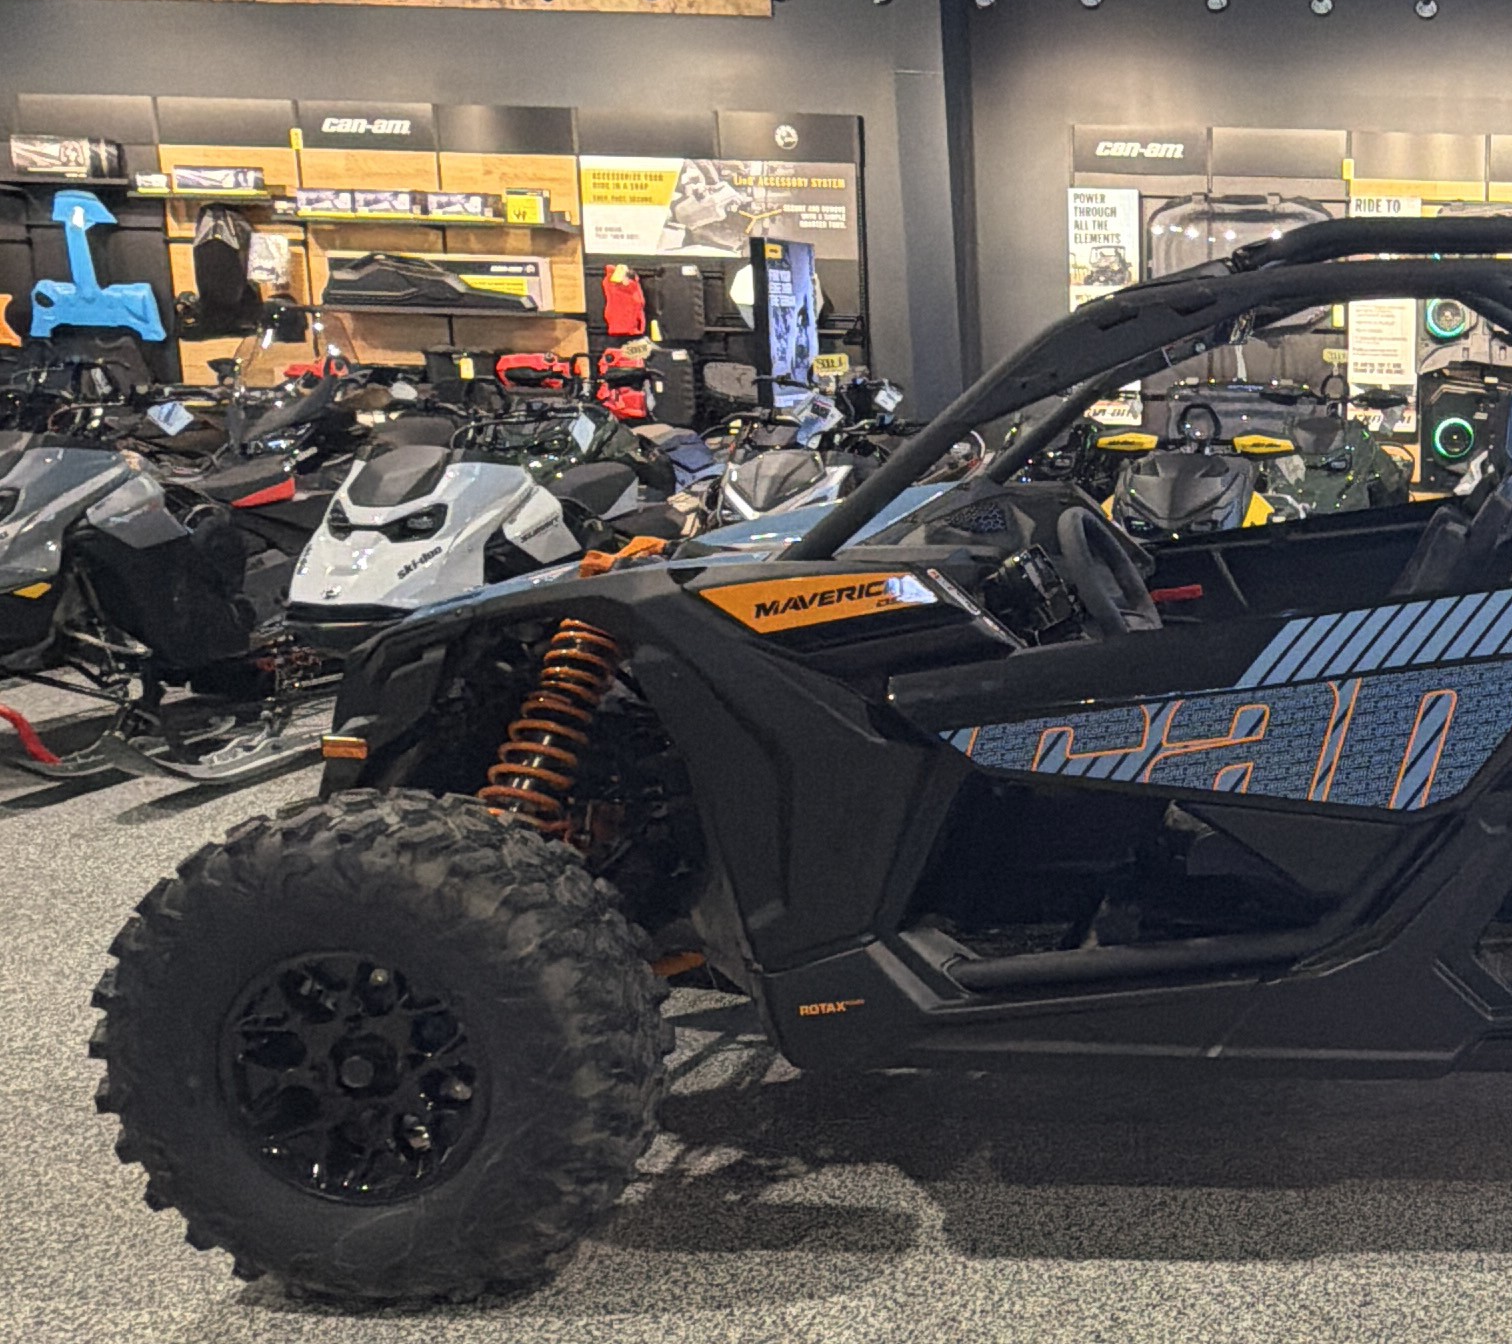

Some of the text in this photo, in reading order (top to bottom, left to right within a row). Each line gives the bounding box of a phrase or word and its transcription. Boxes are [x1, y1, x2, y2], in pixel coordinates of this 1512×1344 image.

[321, 117, 411, 134] can-am
[1095, 140, 1184, 159] can-am
[757, 176, 808, 187] ACCESSORY
[810, 178, 846, 189] SYSTEM
[1073, 193, 1106, 204] POWER
[1073, 206, 1117, 218] THROUGH
[1355, 199, 1401, 213] RIDE TO
[1073, 220, 1108, 231] ALL THE
[1073, 233, 1122, 245] ELEMENTS
[397, 545, 443, 580] ski-doo
[799, 1001, 847, 1016] ROTAX
